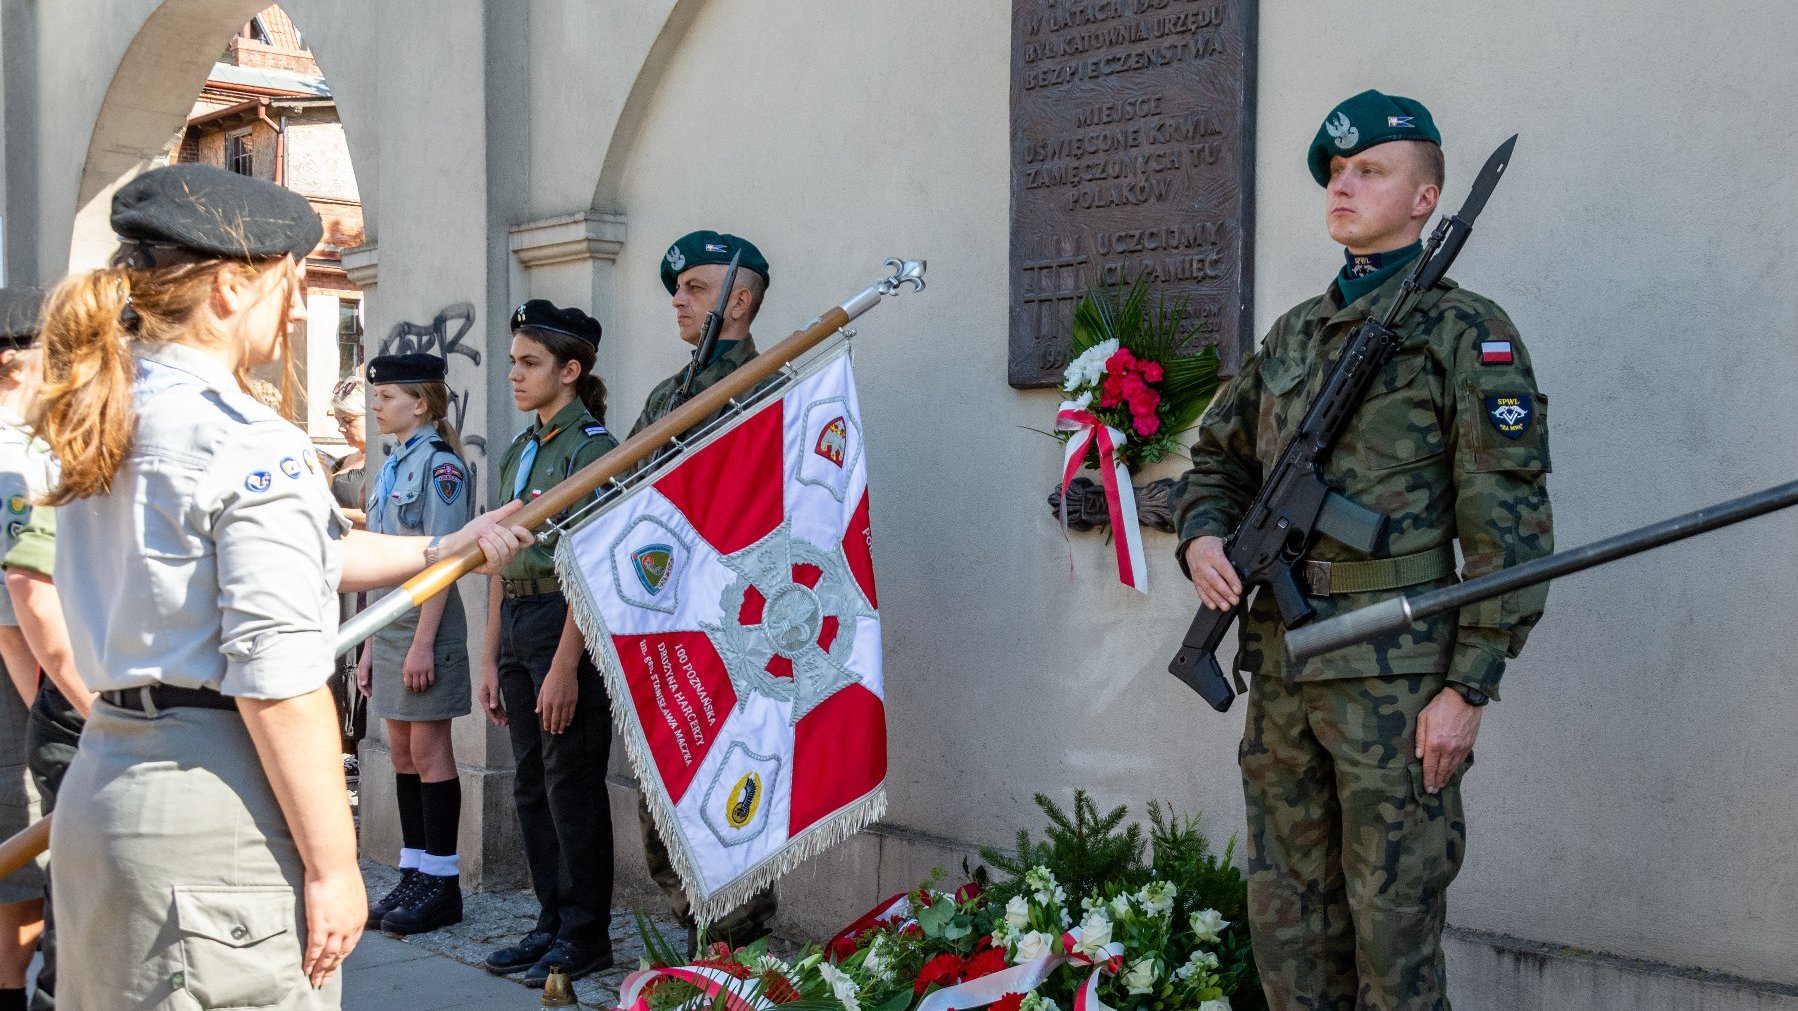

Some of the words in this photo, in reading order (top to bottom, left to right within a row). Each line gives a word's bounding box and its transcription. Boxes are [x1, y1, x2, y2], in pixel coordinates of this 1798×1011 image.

[1075, 96, 1164, 129] MIEJSCE
[1190, 143, 1222, 169] TU
[1497, 398, 1520, 406] SPWL
[657, 642, 678, 694] DRUŻYNA
[673, 691, 705, 746] HARCERZY
[674, 643, 688, 664] 100
[682, 662, 717, 726] POZNAŃSKA
[650, 673, 679, 729] STANISŁAWA
[674, 728, 694, 767] MACZKA
